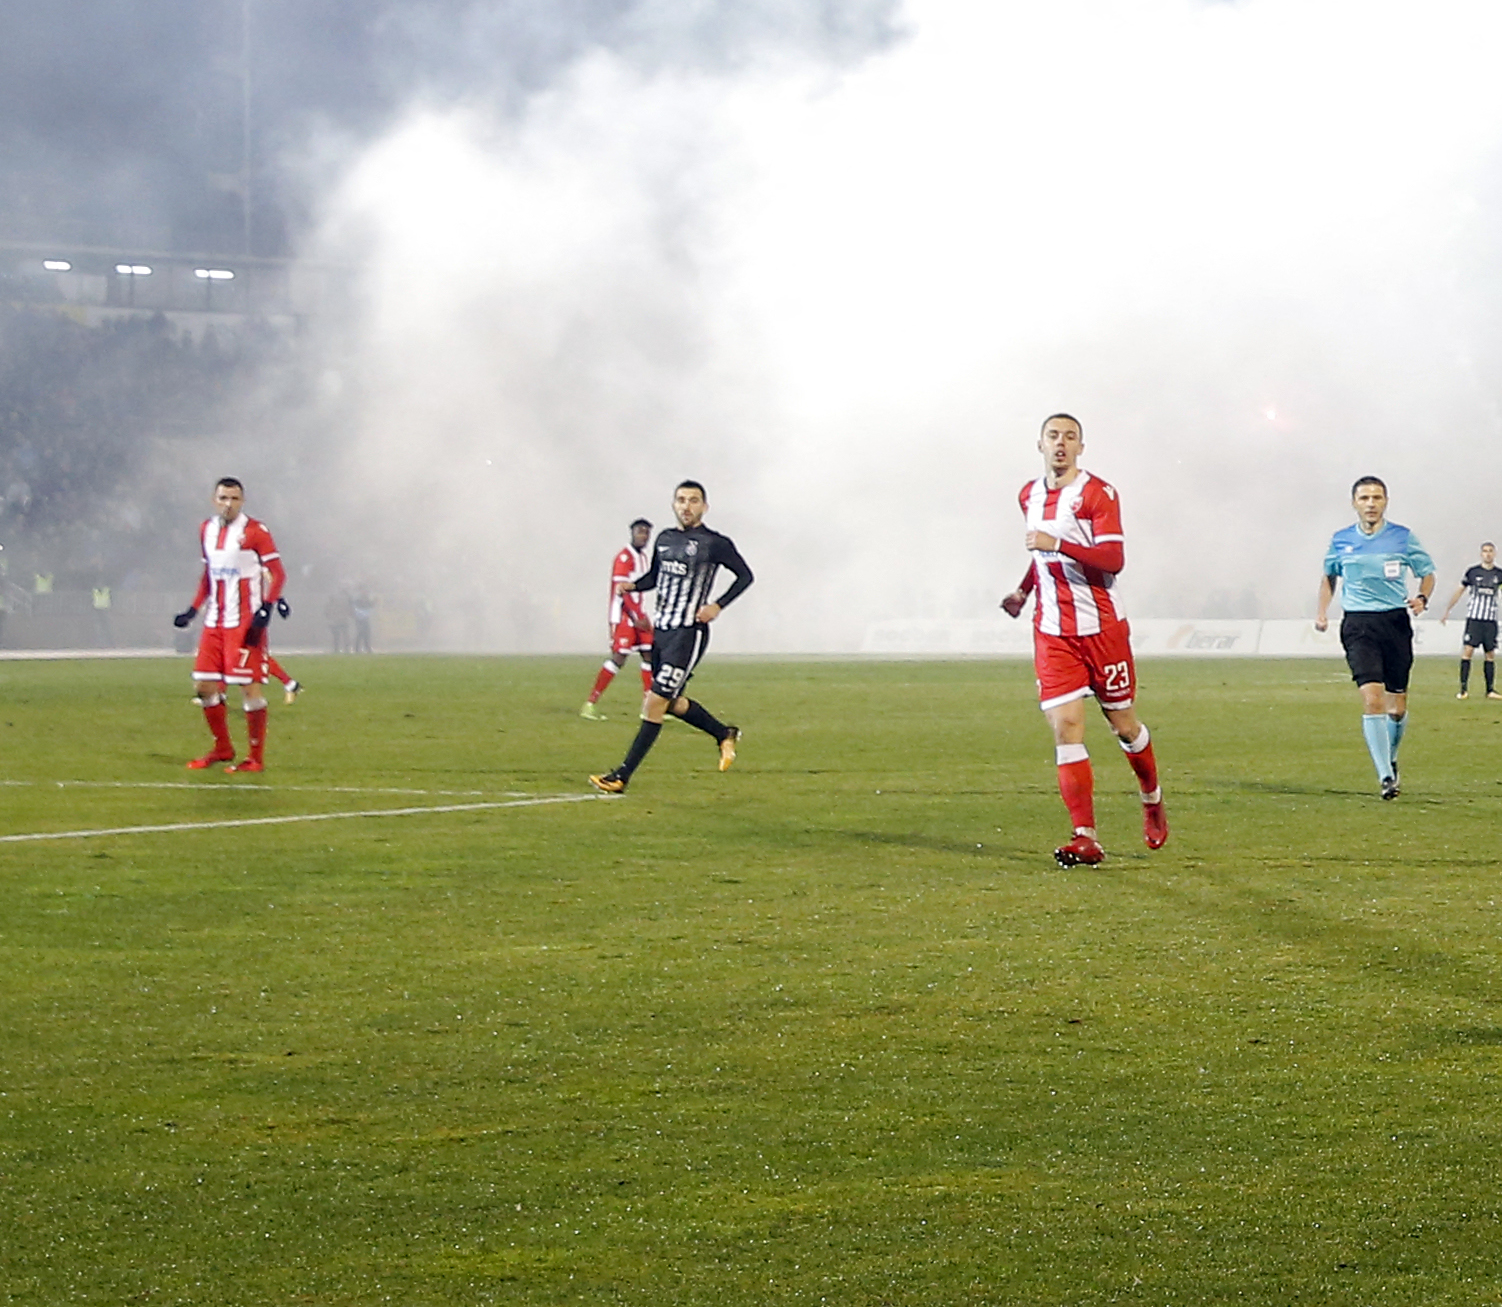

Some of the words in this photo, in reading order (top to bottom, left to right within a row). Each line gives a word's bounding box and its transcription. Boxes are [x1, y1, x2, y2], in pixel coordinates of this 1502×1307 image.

[239, 648, 250, 668] 7
[656, 664, 685, 688] 29
[1104, 661, 1131, 690] 23
